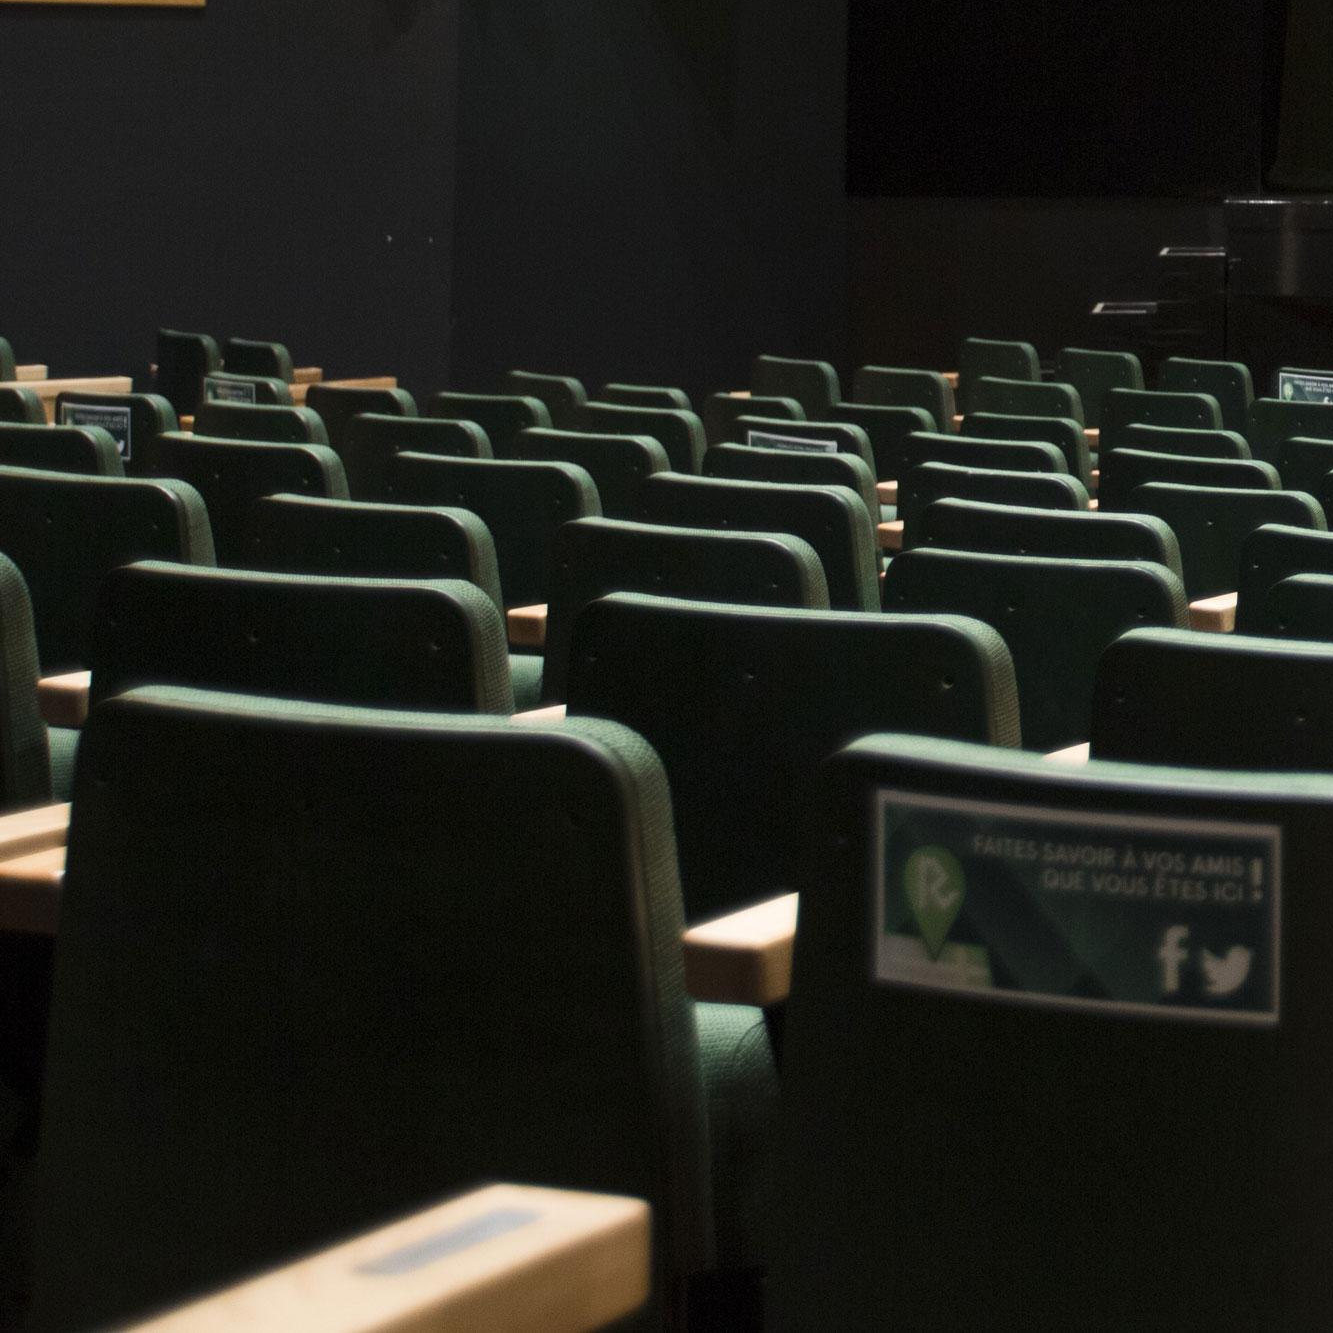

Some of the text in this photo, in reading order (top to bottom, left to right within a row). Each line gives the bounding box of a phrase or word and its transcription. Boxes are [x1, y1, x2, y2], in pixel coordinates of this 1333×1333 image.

[974, 834, 1039, 861] FAITES
[1042, 841, 1115, 868] SAVOIR
[1142, 850, 1185, 872] VOS
[1190, 854, 1244, 877] AMIS
[1042, 868, 1244, 904] QUE VOUS ÊTES ICI
